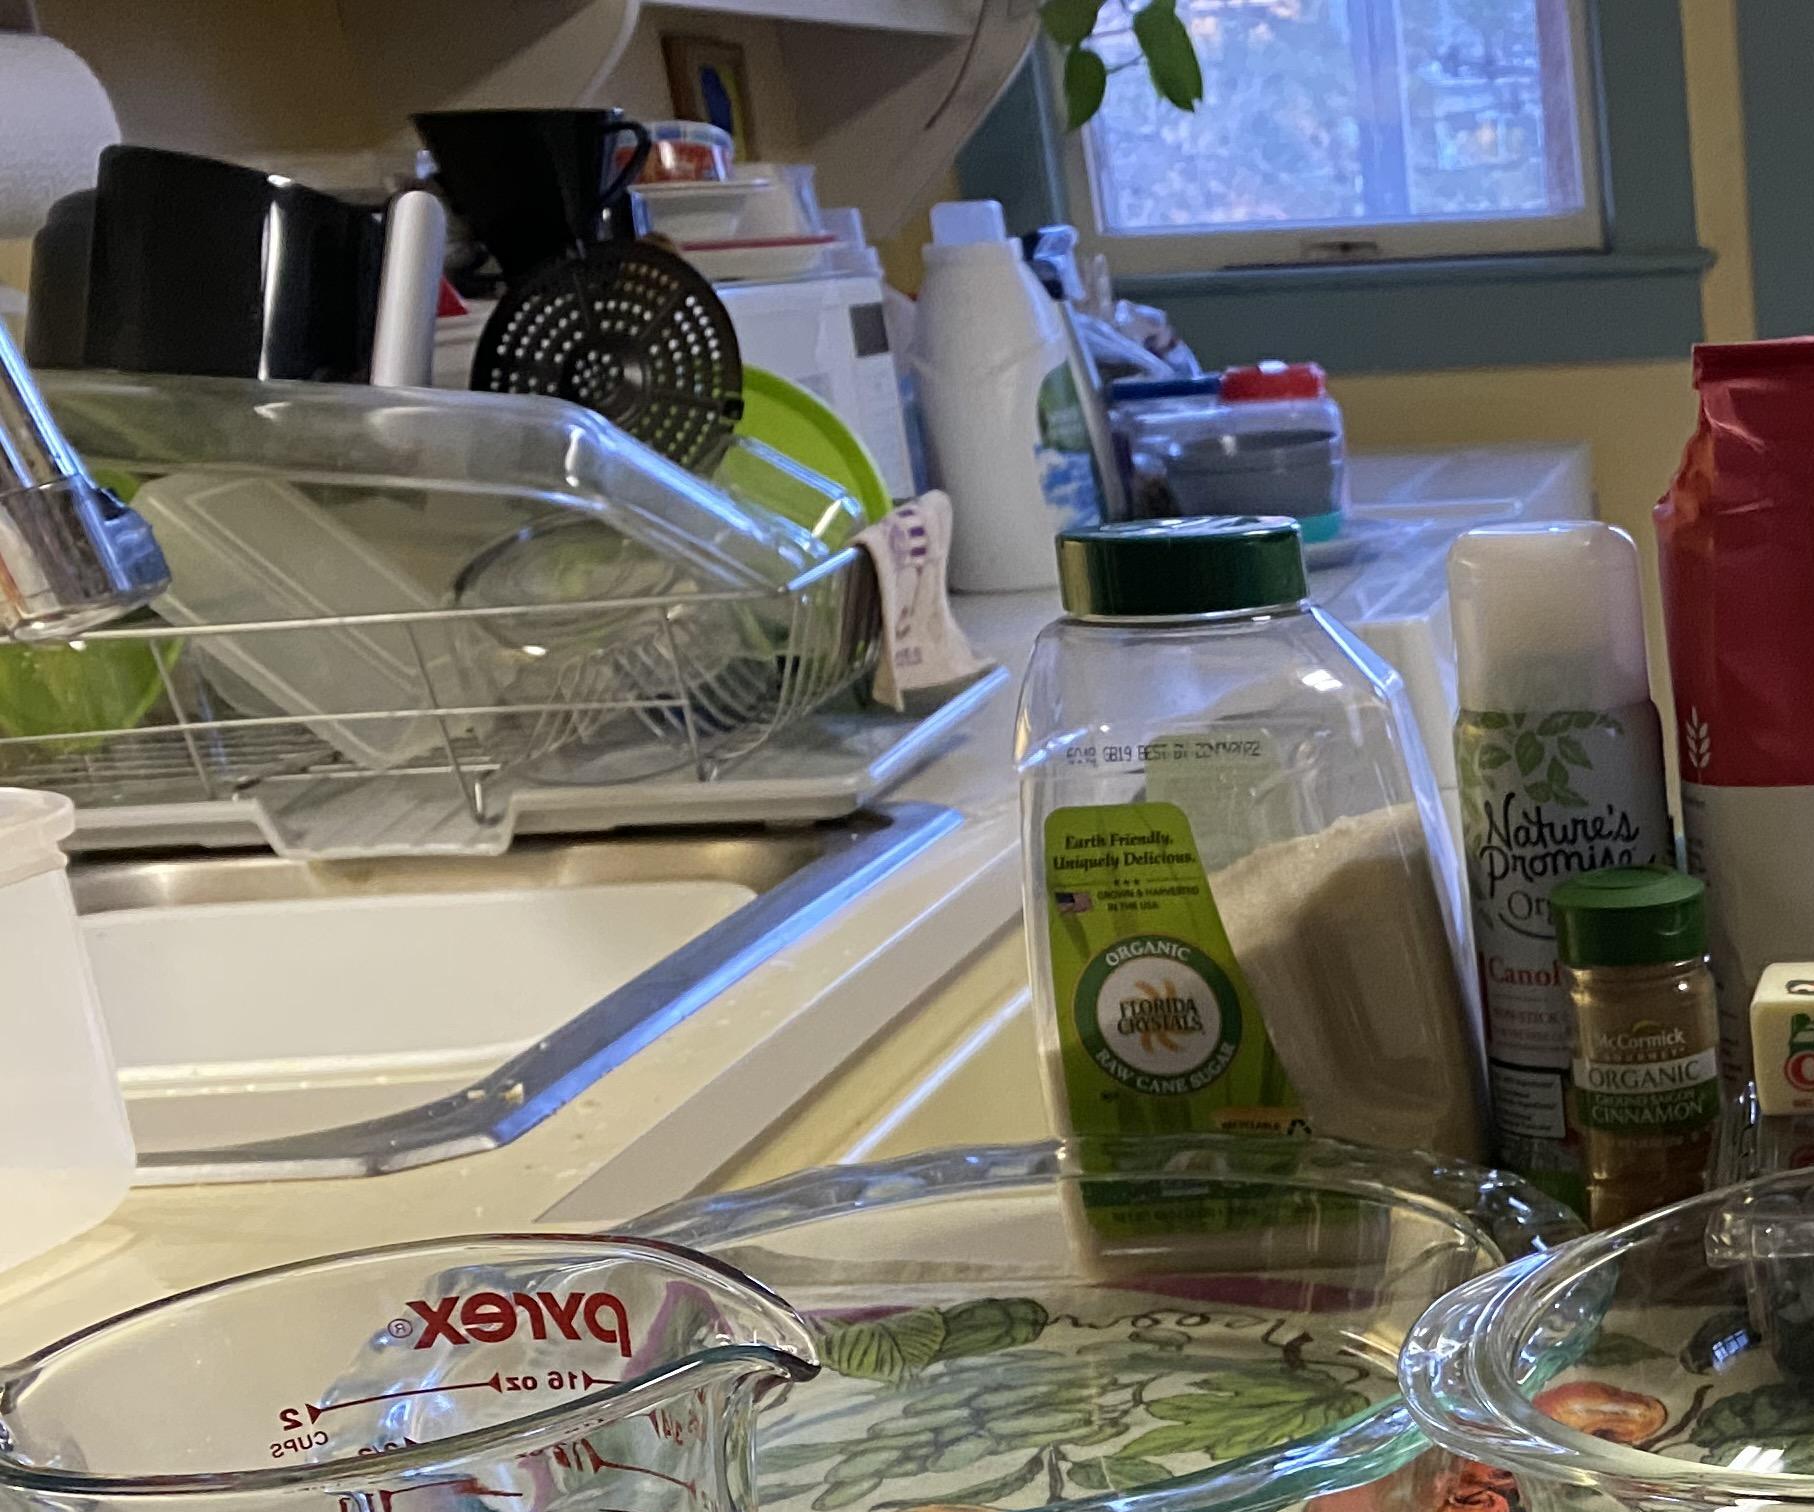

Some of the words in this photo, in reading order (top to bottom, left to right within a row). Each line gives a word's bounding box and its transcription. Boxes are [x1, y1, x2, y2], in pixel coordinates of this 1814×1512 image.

[1484, 792, 1640, 851] Nature's
[1065, 835, 1106, 850] Earth
[1053, 853, 1119, 871] Uniquely
[1104, 939, 1192, 967] ORGANIC
[1488, 955, 1563, 987] Canol
[1118, 998, 1198, 1018] FLORIDA
[1095, 1048, 1136, 1081] RAW
[1136, 1076, 1189, 1093] CANE
[1190, 1042, 1236, 1089] SUGAR
[1588, 1059, 1699, 1090] ORGANIC
[1592, 1100, 1704, 1125] CINNAMON
